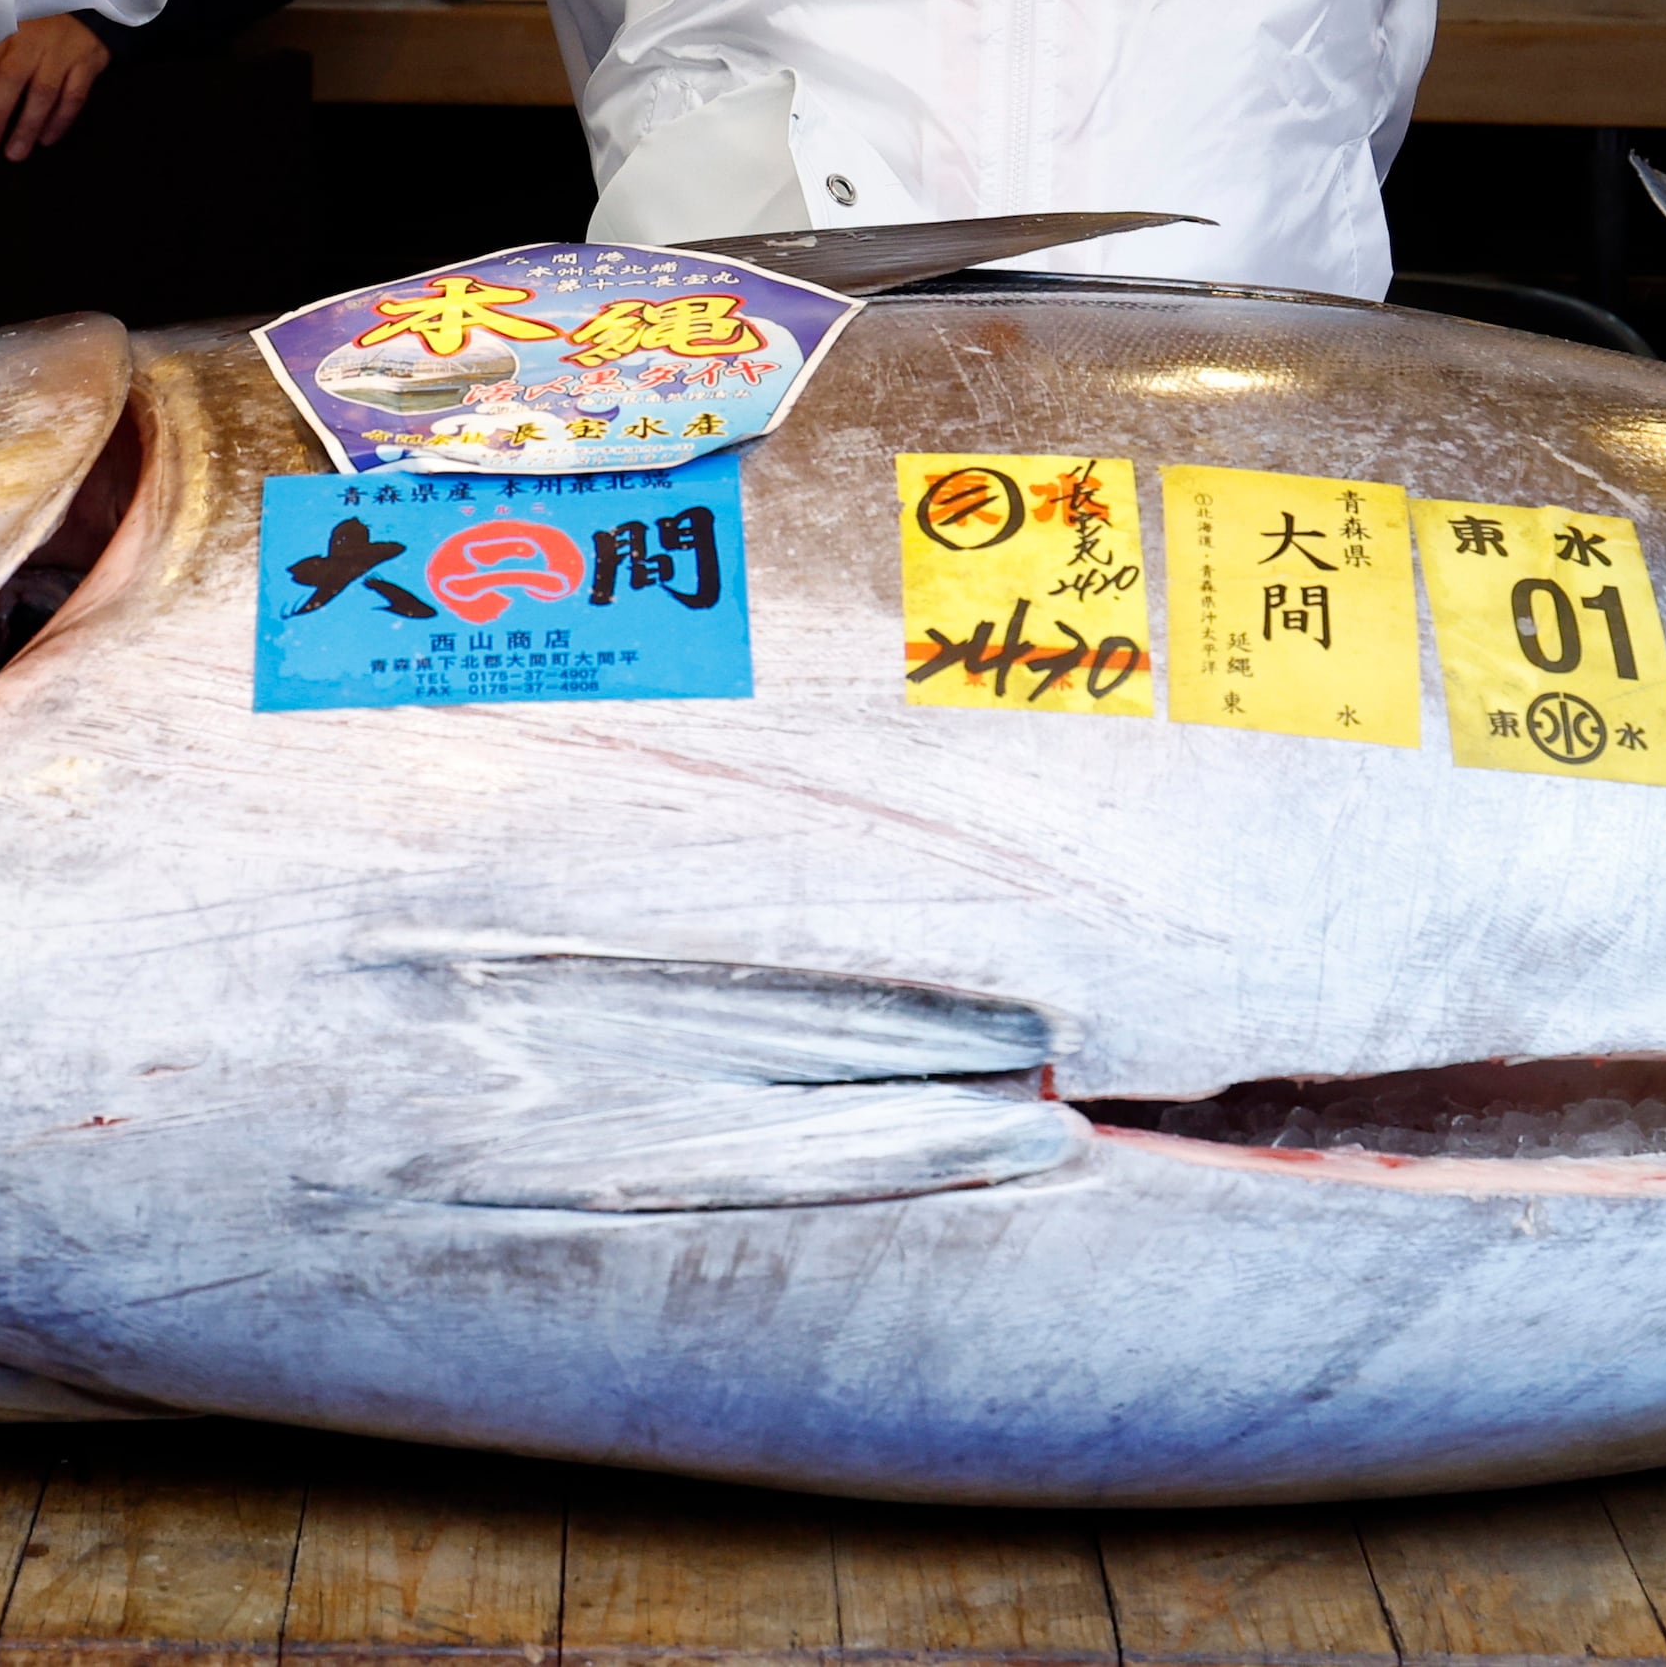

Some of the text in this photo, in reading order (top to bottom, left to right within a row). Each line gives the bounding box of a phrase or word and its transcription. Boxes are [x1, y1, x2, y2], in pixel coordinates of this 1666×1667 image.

[336, 471, 675, 507] 青森県産 本州最北端
[1334, 490, 1373, 569] 青森県
[1257, 510, 1340, 652] 大間
[429, 628, 572, 653] 西山商店
[1510, 577, 1641, 683] 01
[415, 684, 451, 698] FAX
[416, 672, 450, 686] TEL
